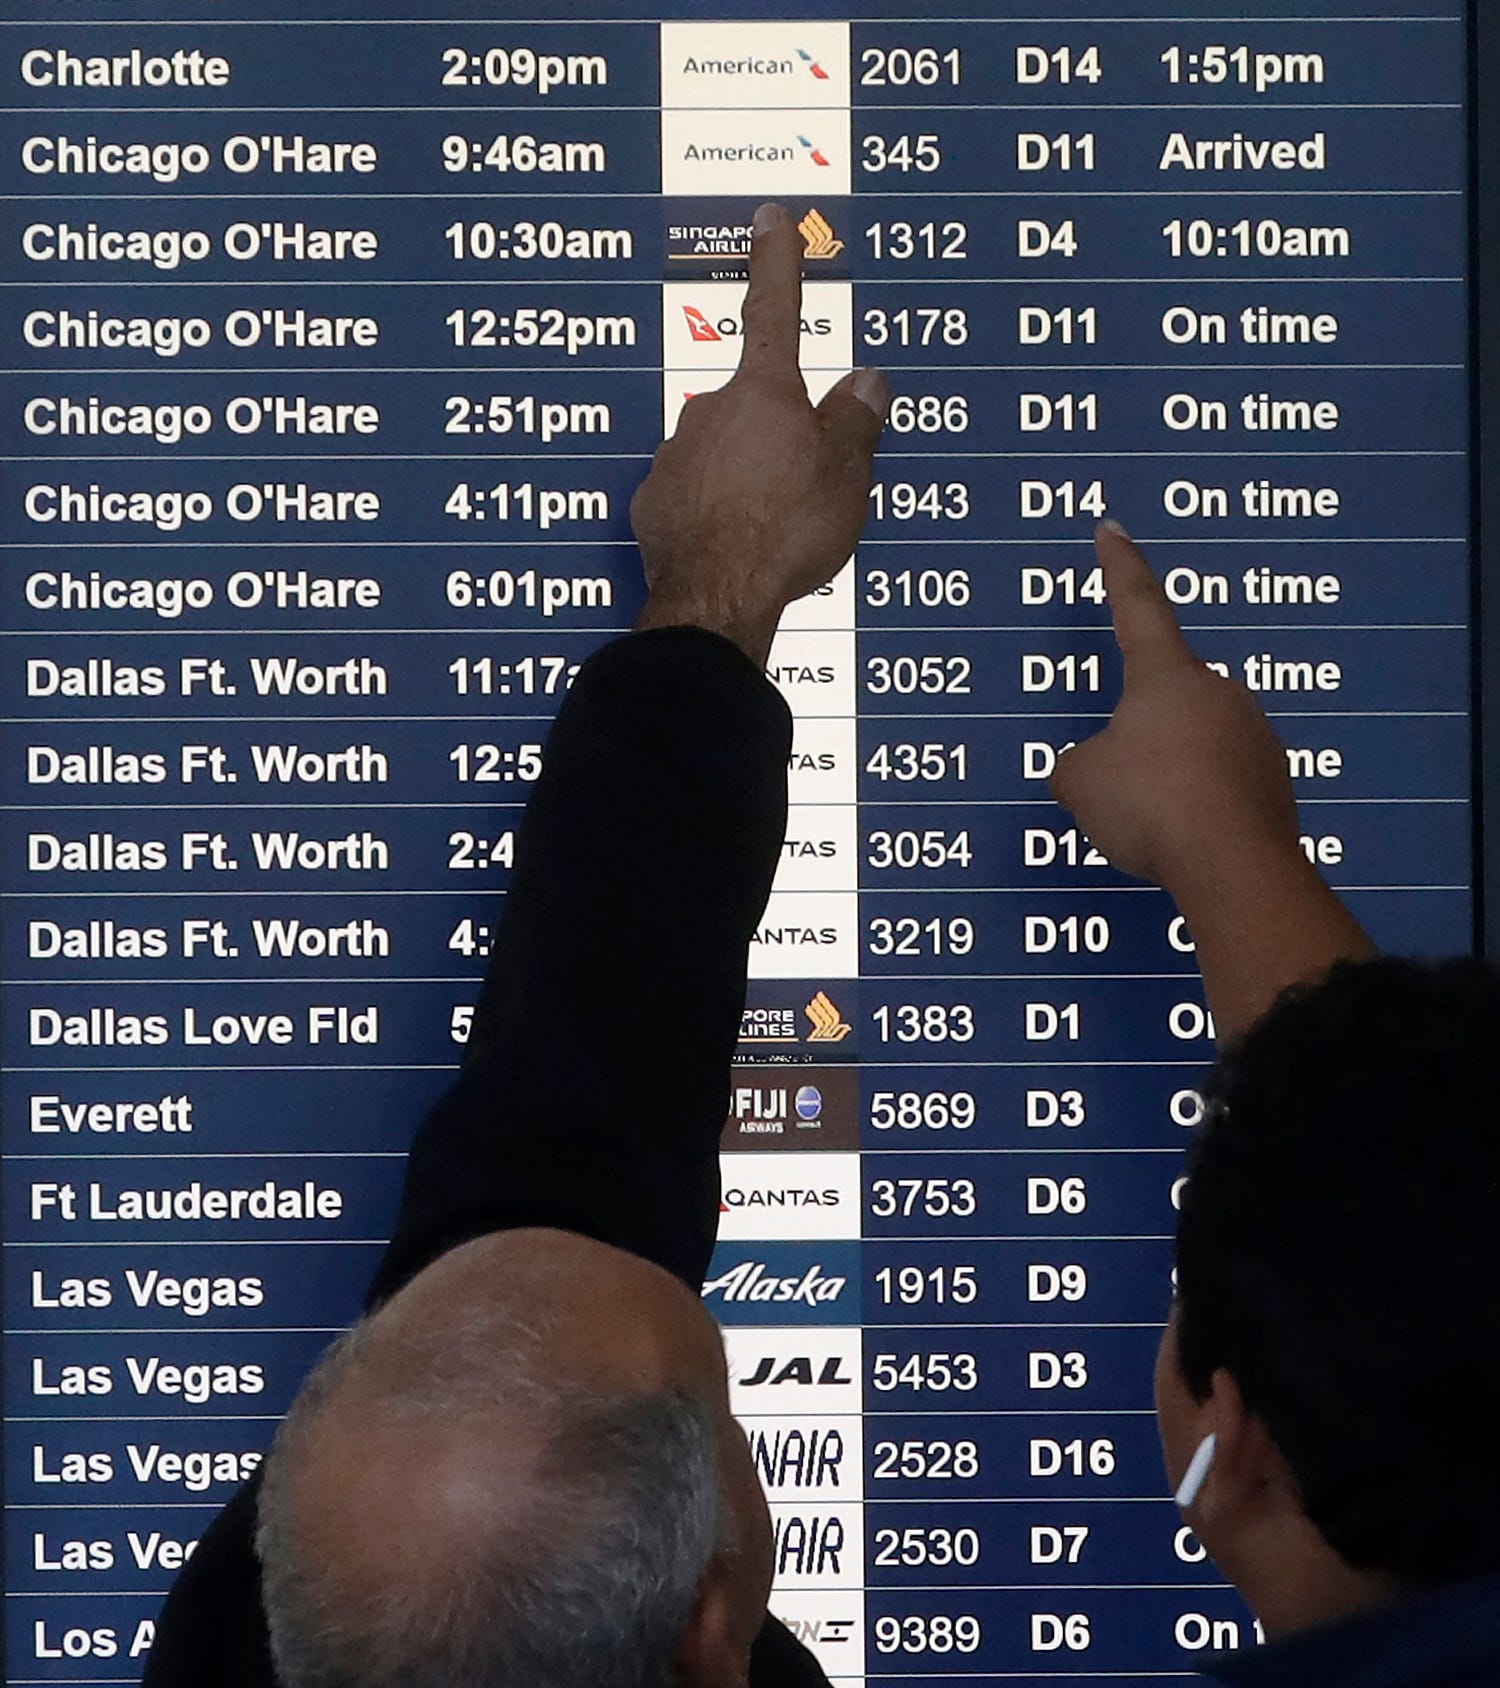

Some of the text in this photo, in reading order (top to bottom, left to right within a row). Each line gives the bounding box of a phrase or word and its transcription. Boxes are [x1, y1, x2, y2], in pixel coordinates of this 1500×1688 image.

[21, 49, 230, 87] Charlotte
[441, 48, 607, 95] 2:09pm
[683, 57, 793, 74] American
[860, 48, 959, 86] 2061
[1016, 46, 1102, 84] D14
[1161, 46, 1324, 93] 1:51pm
[442, 135, 605, 172] 9:46am
[684, 144, 794, 161] American
[1017, 133, 1094, 171] D11
[1159, 132, 1325, 170] Arrived
[22, 222, 378, 270] Chicago O'Hare
[445, 221, 633, 259] 10:30am
[865, 222, 967, 260] 1312
[1018, 220, 1078, 257] D4
[1162, 219, 1349, 257] 10:10am
[446, 308, 636, 356] 12:52pm
[863, 308, 968, 346] 3178
[1161, 306, 1338, 344] On time
[24, 396, 379, 444] Chicago O'Hare
[445, 396, 610, 443] 2:51pm
[879, 395, 969, 433] 686
[869, 482, 969, 520] 1943
[446, 570, 612, 617] 6:01pm
[1021, 567, 1107, 605] D14
[27, 657, 387, 697] Dallas Ft. Worth
[449, 657, 581, 695] 11:17
[866, 656, 971, 694] 3052
[1243, 653, 1341, 691] time
[868, 830, 973, 868] 3054
[29, 919, 389, 958] Dallas Ft. Worth
[751, 928, 837, 944] ANTAS
[30, 1006, 378, 1046] Dallas Love Fld
[739, 1024, 795, 1036] LINES
[873, 1005, 974, 1042] 1383
[30, 1095, 193, 1133] Everett
[736, 1088, 786, 1118] FIJI
[1026, 1090, 1085, 1127] D3
[31, 1181, 343, 1220] Ft Lauderdale
[725, 1189, 840, 1206] QANTAS
[871, 1179, 976, 1217] 3753
[1027, 1177, 1086, 1214] D6
[700, 1261, 846, 1307] Alaska
[875, 1266, 977, 1304] 1915
[738, 1357, 852, 1386] JAL
[1029, 1352, 1087, 1389] D3
[33, 1444, 263, 1491] Las Vegas
[873, 1441, 979, 1478] 2528
[1030, 1439, 1115, 1476] D16
[34, 1533, 114, 1570] Las
[874, 1528, 979, 1566] 2530
[34, 1620, 118, 1658] Los
[1031, 1613, 1090, 1651] D6
